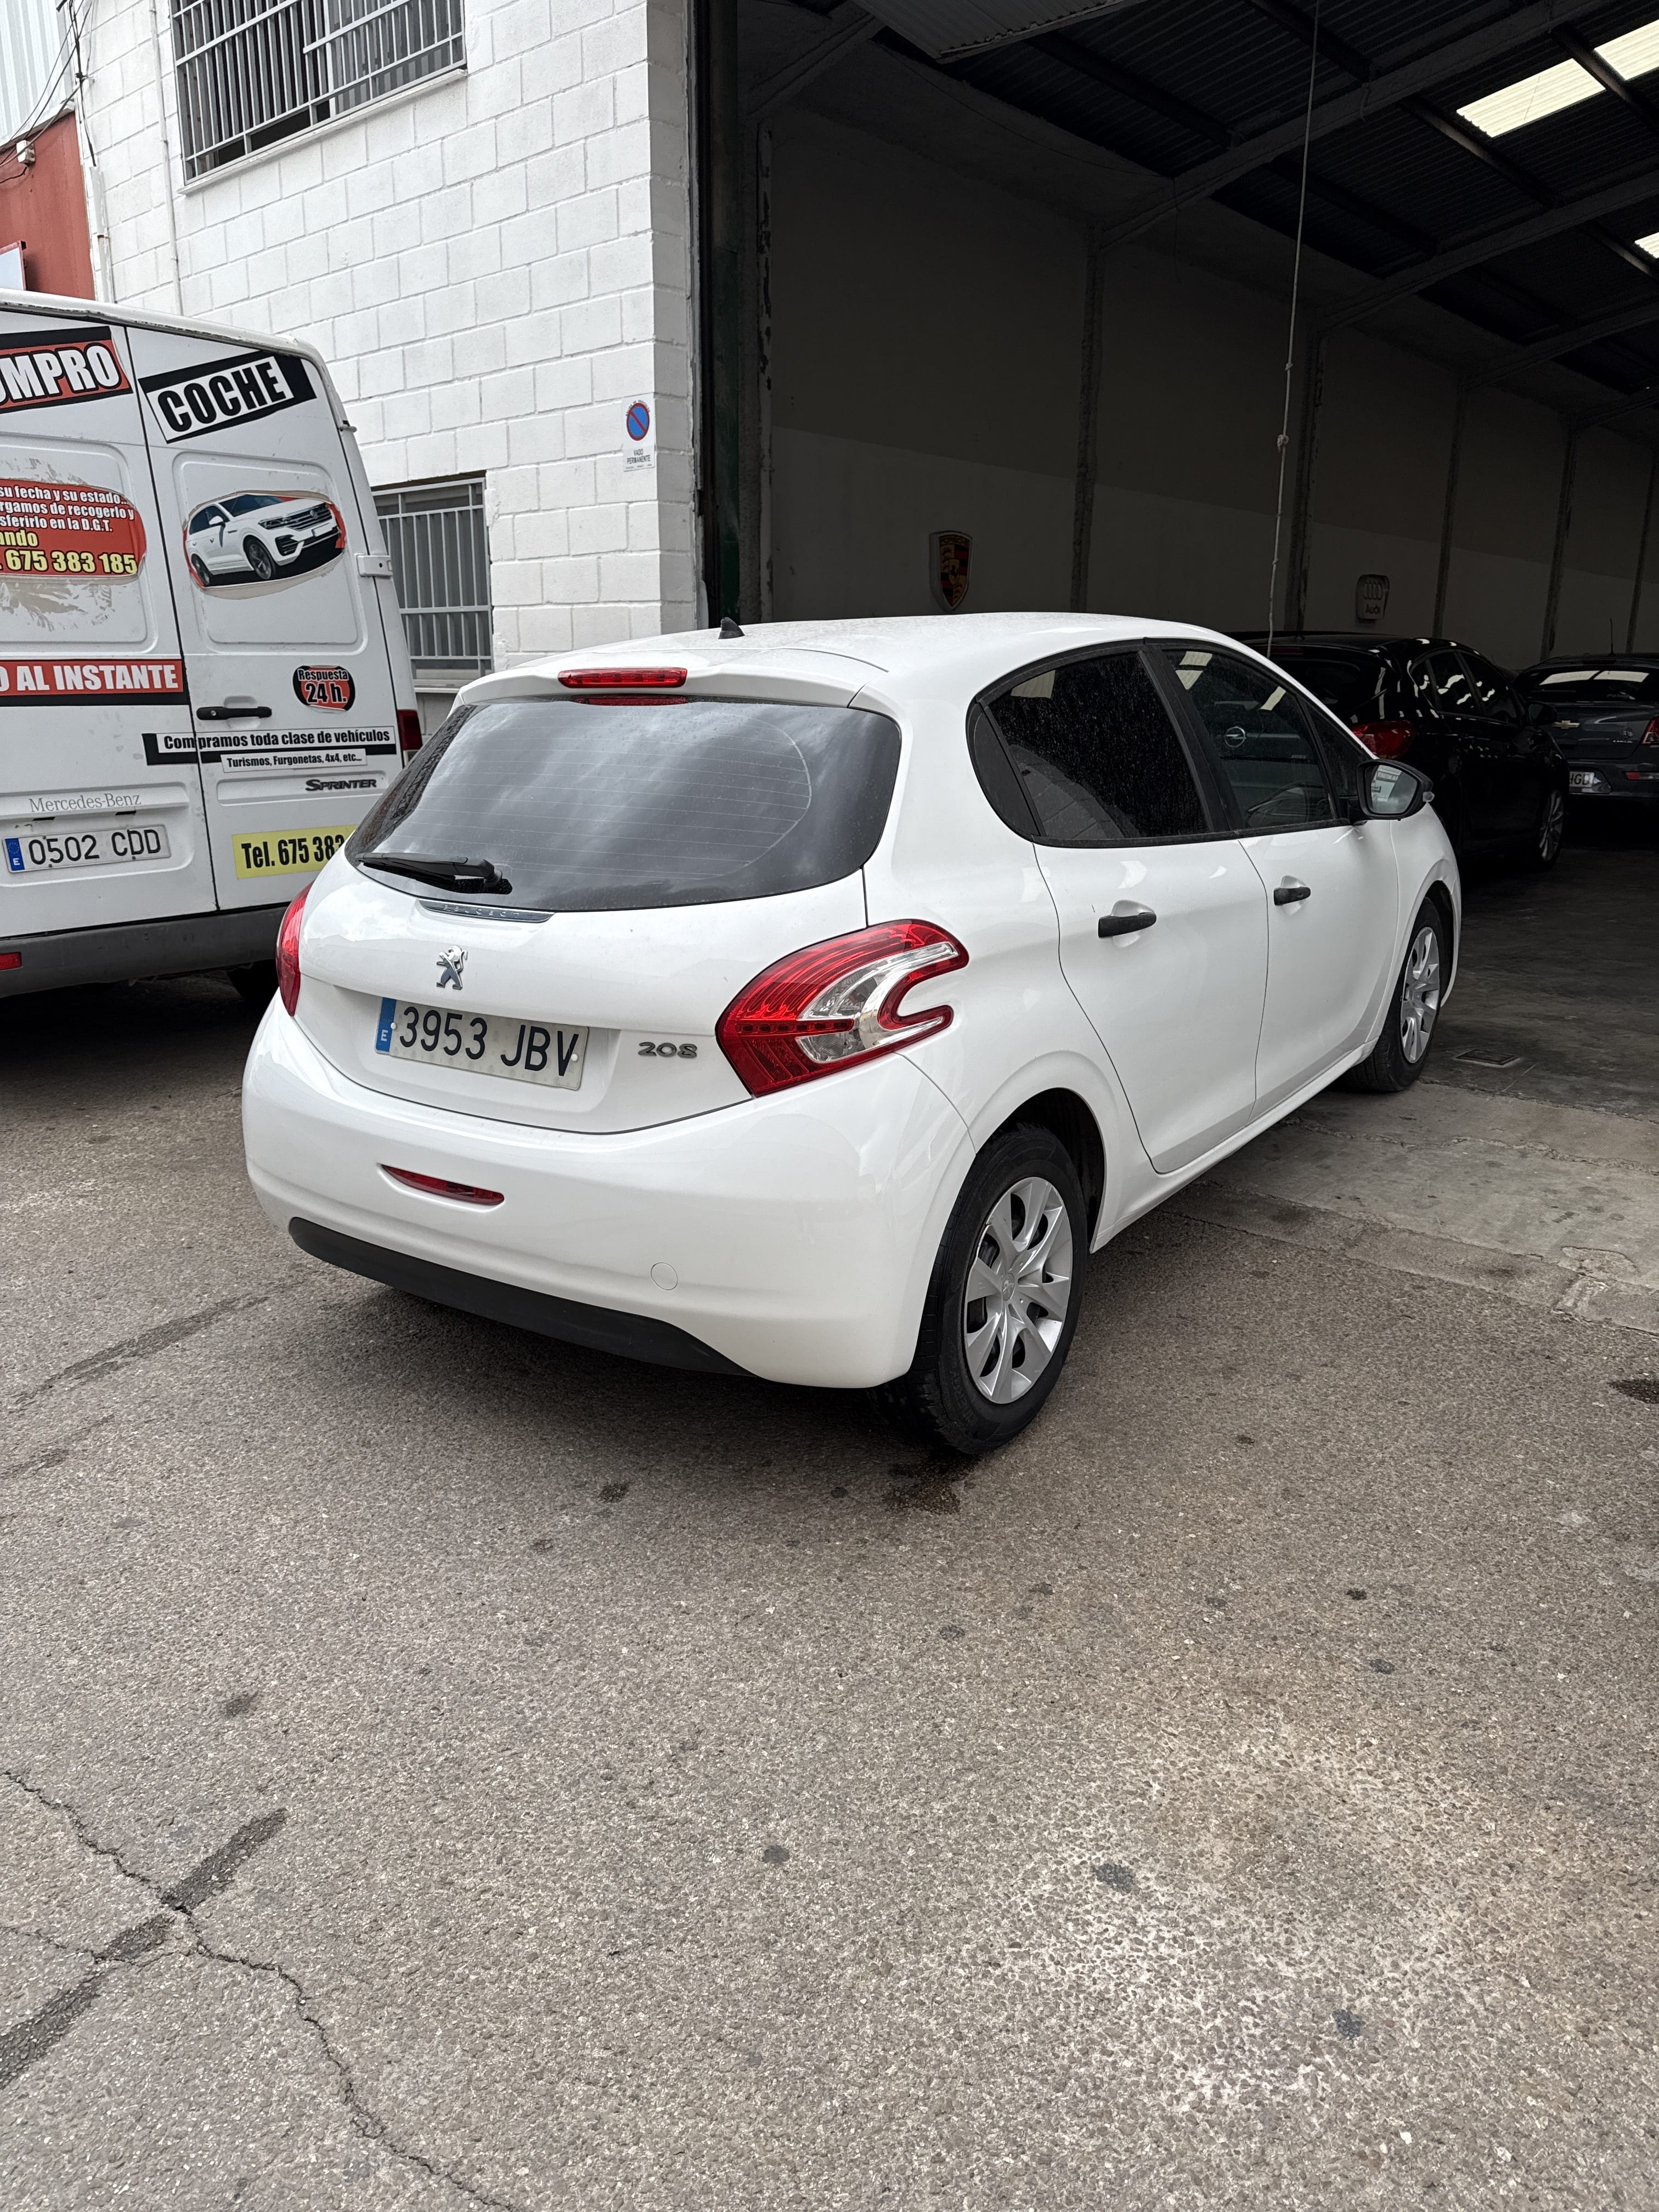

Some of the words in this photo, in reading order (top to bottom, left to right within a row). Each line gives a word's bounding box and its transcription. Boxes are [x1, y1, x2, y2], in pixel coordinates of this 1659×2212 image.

[157, 361, 286, 432] COCHE
[627, 455, 651, 465] PERMANENTE
[15, 486, 52, 500] fecha
[53, 490, 61, 502] y
[63, 490, 78, 501] su
[50, 503, 66, 515] de
[68, 505, 125, 519] recogerlo
[127, 509, 134, 521] y
[0, 515, 48, 529] sferirlo
[50, 518, 66, 530] en
[68, 517, 80, 530] la
[82, 518, 113, 532] D.G.T.
[5, 549, 48, 572] 675
[51, 551, 96, 572] 383
[98, 552, 138, 573] 185
[16, 665, 50, 691] AL
[53, 664, 179, 691] INSTANTE
[298, 669, 348, 681] Respuesta
[306, 683, 328, 703] 24
[330, 683, 346, 702] h.
[163, 735, 249, 750] Compramos
[250, 732, 279, 747] toda
[281, 731, 314, 745] clase
[317, 731, 332, 743] de
[334, 729, 390, 743] vehículos
[227, 757, 273, 768] Turismos,
[273, 754, 324, 766] Furgonetas,
[325, 753, 342, 764] 4x4,
[28, 793, 142, 813] Mercedes-Benz
[29, 834, 99, 865] 0502
[111, 828, 161, 856] CDD
[241, 842, 275, 869] Tel.
[278, 838, 309, 866] 675
[442, 904, 520, 918] PEUGEOT
[381, 1029, 388, 1042] E
[399, 1006, 488, 1060] 3953
[500, 1024, 579, 1077] JBV
[638, 1041, 697, 1058] 208
